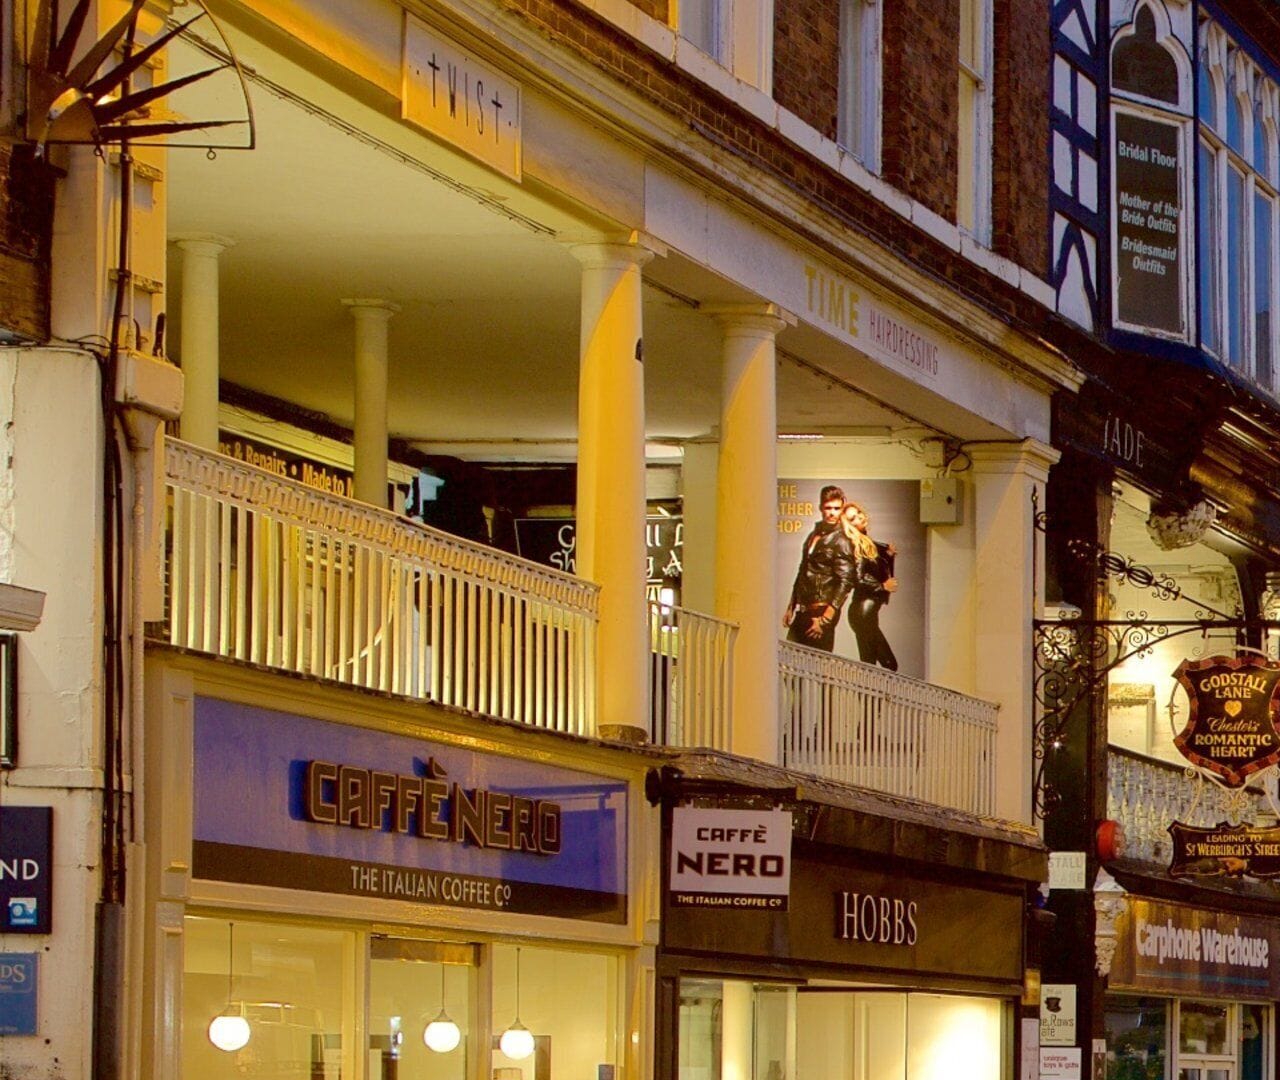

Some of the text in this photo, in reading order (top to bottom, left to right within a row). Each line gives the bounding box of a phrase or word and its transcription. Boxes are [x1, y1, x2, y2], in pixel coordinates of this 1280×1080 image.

[1119, 140, 1178, 168] Bridal Floor
[1120, 191, 1178, 217] Mother of the
[1122, 209, 1177, 234] Bride Outfits
[1121, 236, 1176, 261] Bridesmaid
[1132, 256, 1166, 275] Outfits
[805, 265, 938, 376] TIME HAIRDRESSING
[1101, 412, 1144, 468] JADE
[235, 442, 242, 461] &
[246, 445, 287, 477] Repairs
[303, 463, 331, 492] Made
[332, 474, 344, 495] to
[776, 521, 802, 534] HOP
[1200, 672, 1267, 694] GODSTALL
[1215, 686, 1252, 699] LANE
[1207, 717, 1260, 733] Chester's
[1195, 734, 1272, 746] ROMANTIC
[1211, 746, 1256, 758] HEART
[308, 757, 561, 855] CAFFÈ NERO
[696, 824, 767, 843] CAFFÈ
[1206, 834, 1262, 843] LEADING TO
[1197, 843, 1252, 856] WERBURGH'S
[677, 851, 784, 877] NERO
[351, 866, 378, 891] THE
[382, 870, 437, 898] ITALIAN
[441, 876, 490, 904] COFFEE
[677, 895, 693, 904] THE
[695, 895, 732, 906] ITALIAN
[734, 897, 767, 907] COFFEE
[842, 891, 917, 945] HOBBS
[1136, 918, 1269, 968] Carphone Warehouse
